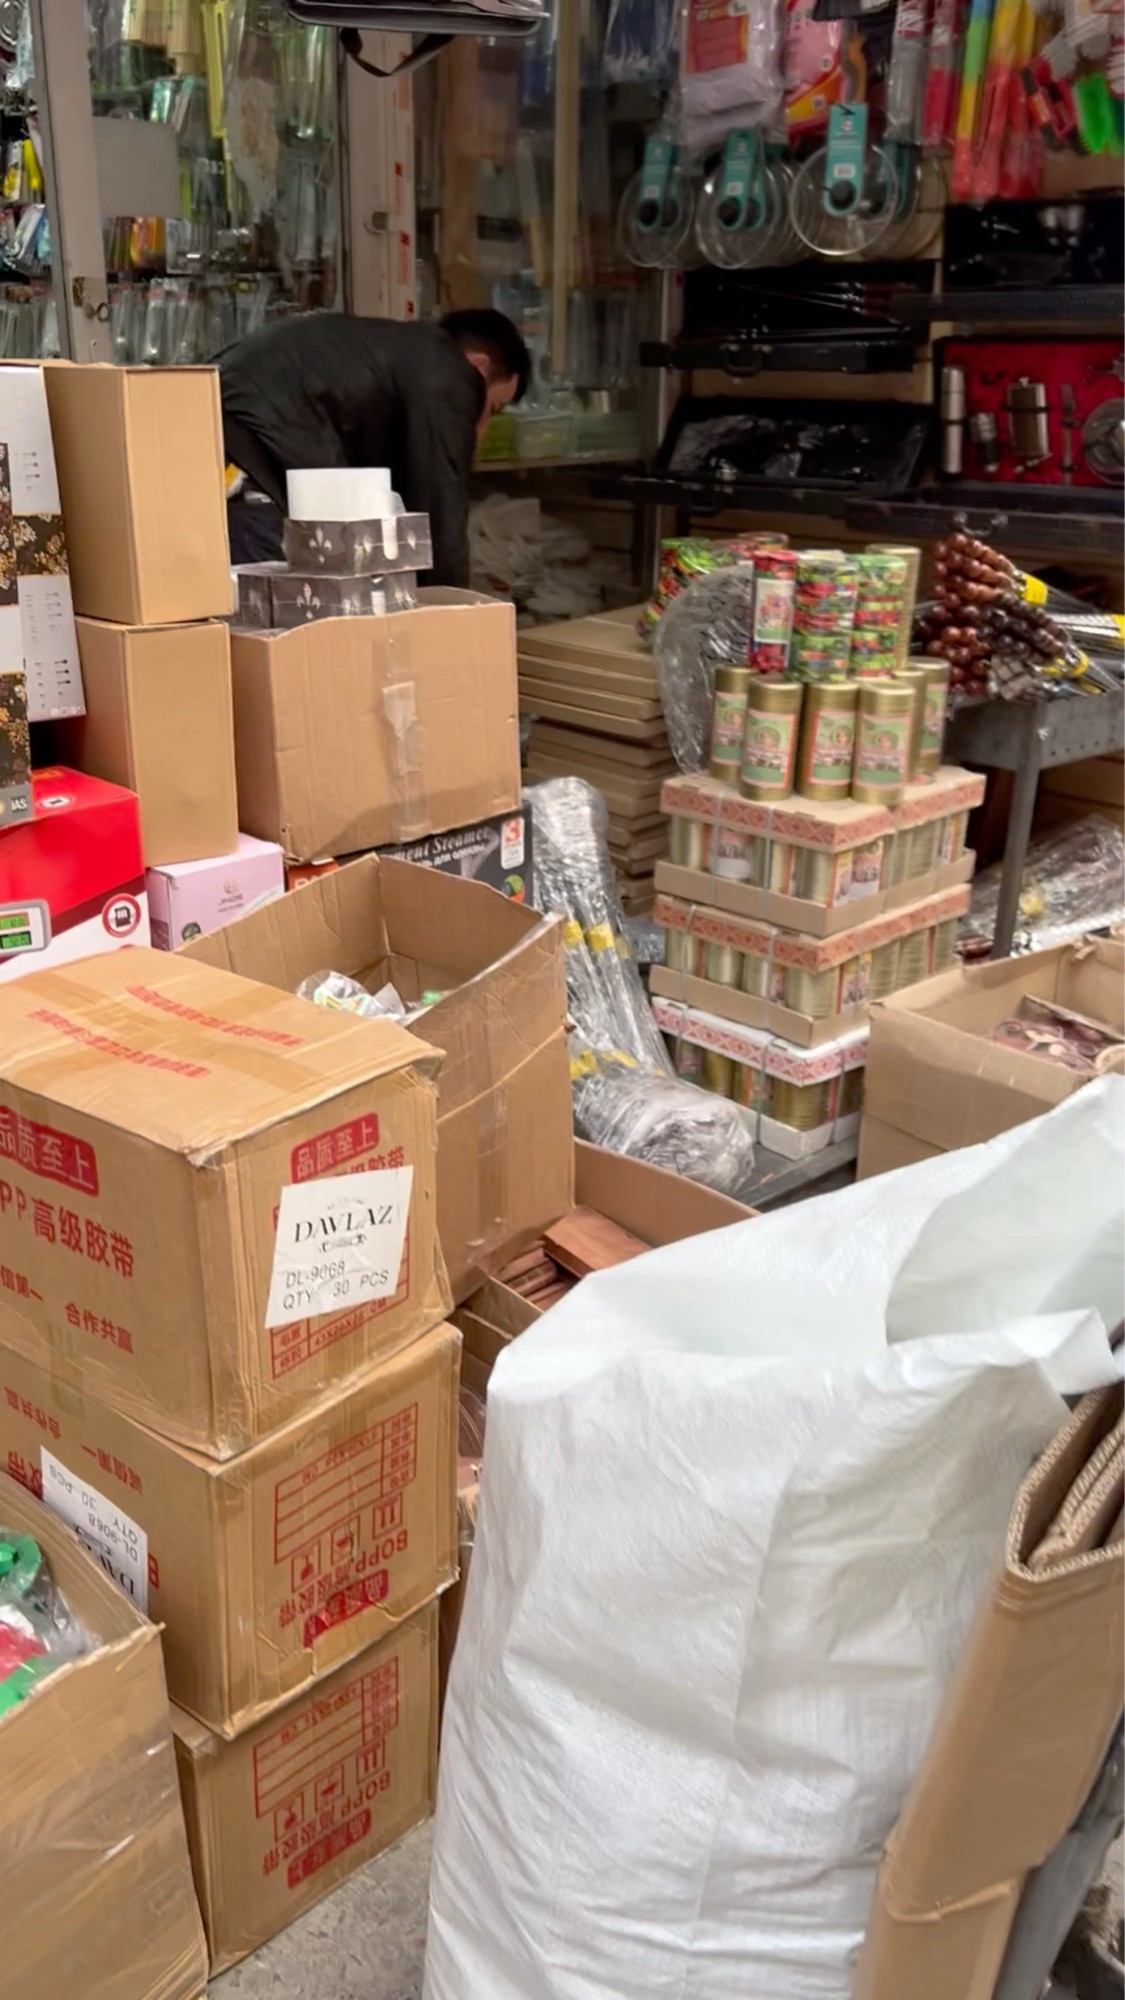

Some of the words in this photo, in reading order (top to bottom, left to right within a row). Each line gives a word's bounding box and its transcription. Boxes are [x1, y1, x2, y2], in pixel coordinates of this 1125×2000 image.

[0, 1113, 95, 1190] 品质至上
[296, 1121, 375, 1180] 品质至上
[286, 1260, 346, 1288] DL-9068
[333, 1279, 350, 1297] 30
[359, 1269, 389, 1288] PCS
